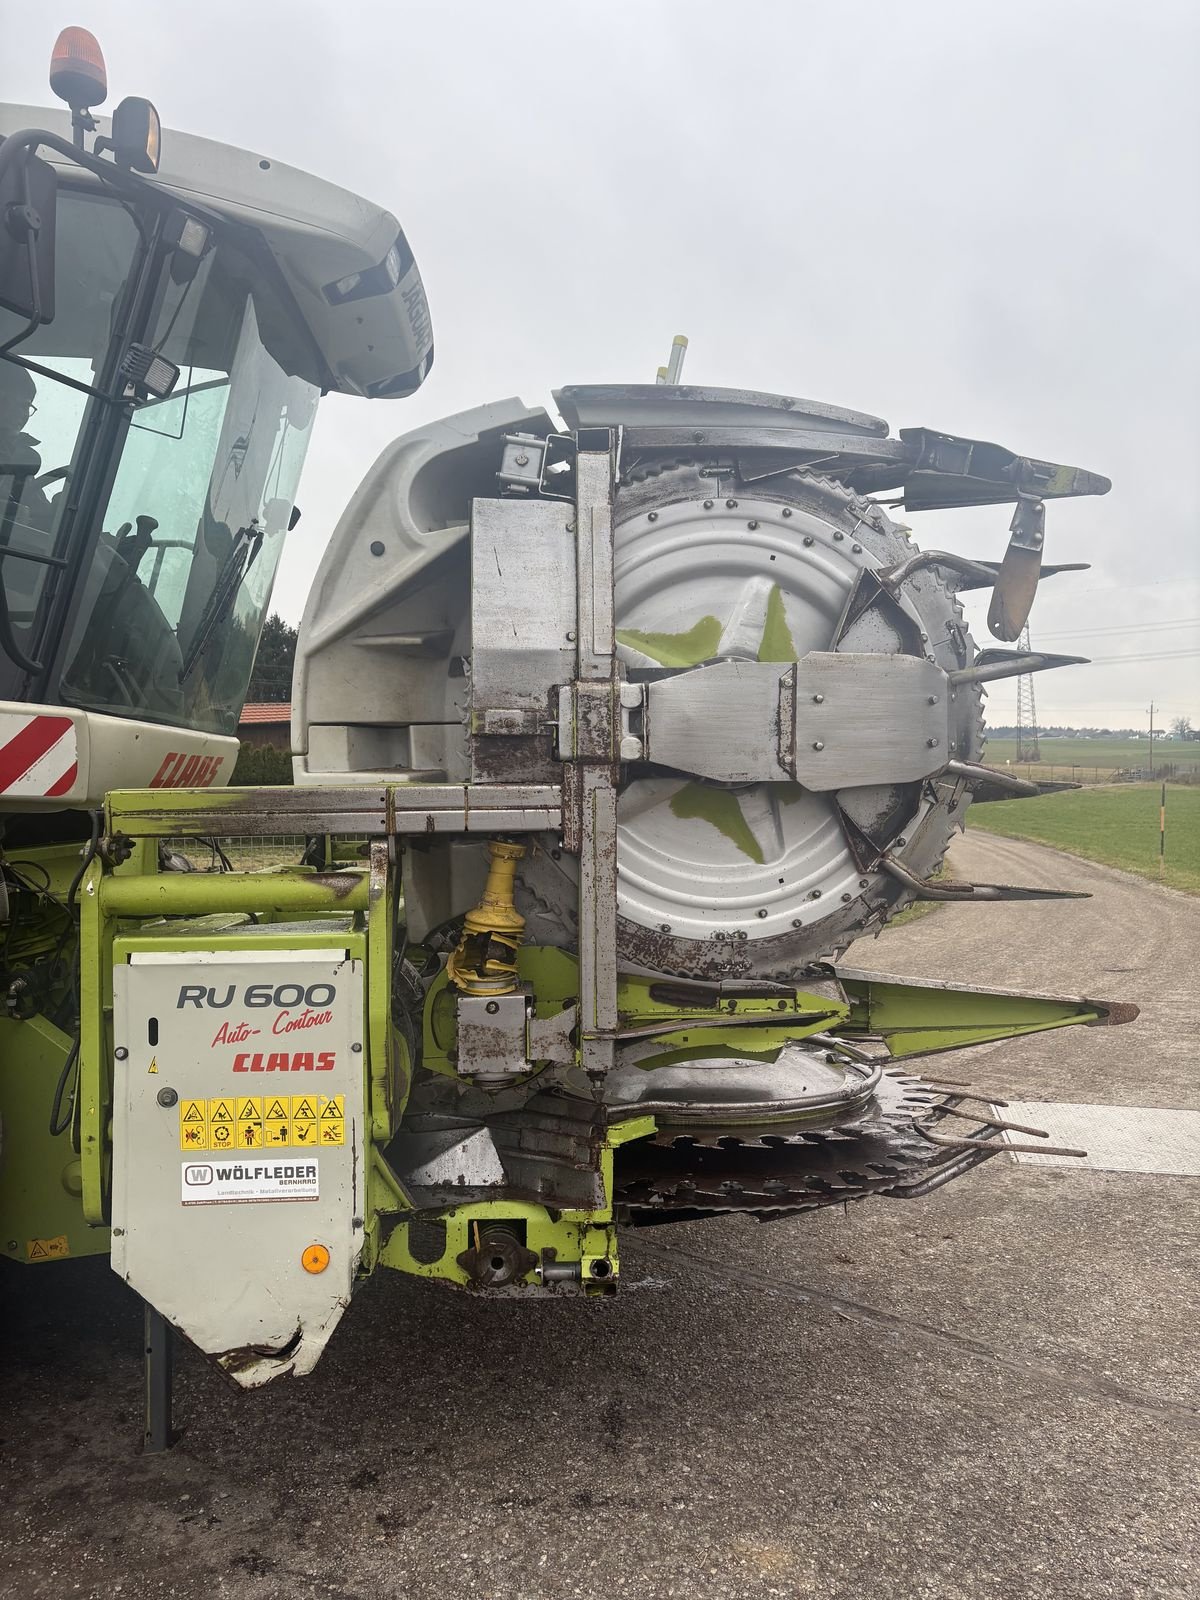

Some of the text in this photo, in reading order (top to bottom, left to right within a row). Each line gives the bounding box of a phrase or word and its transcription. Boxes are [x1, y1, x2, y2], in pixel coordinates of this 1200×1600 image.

[148, 752, 224, 788] CLAAS
[176, 983, 336, 1009] RU 600
[271, 1008, 333, 1035] Contour
[232, 1052, 336, 1073] CLAAS
[216, 1165, 316, 1180] WÖLFLEDER
